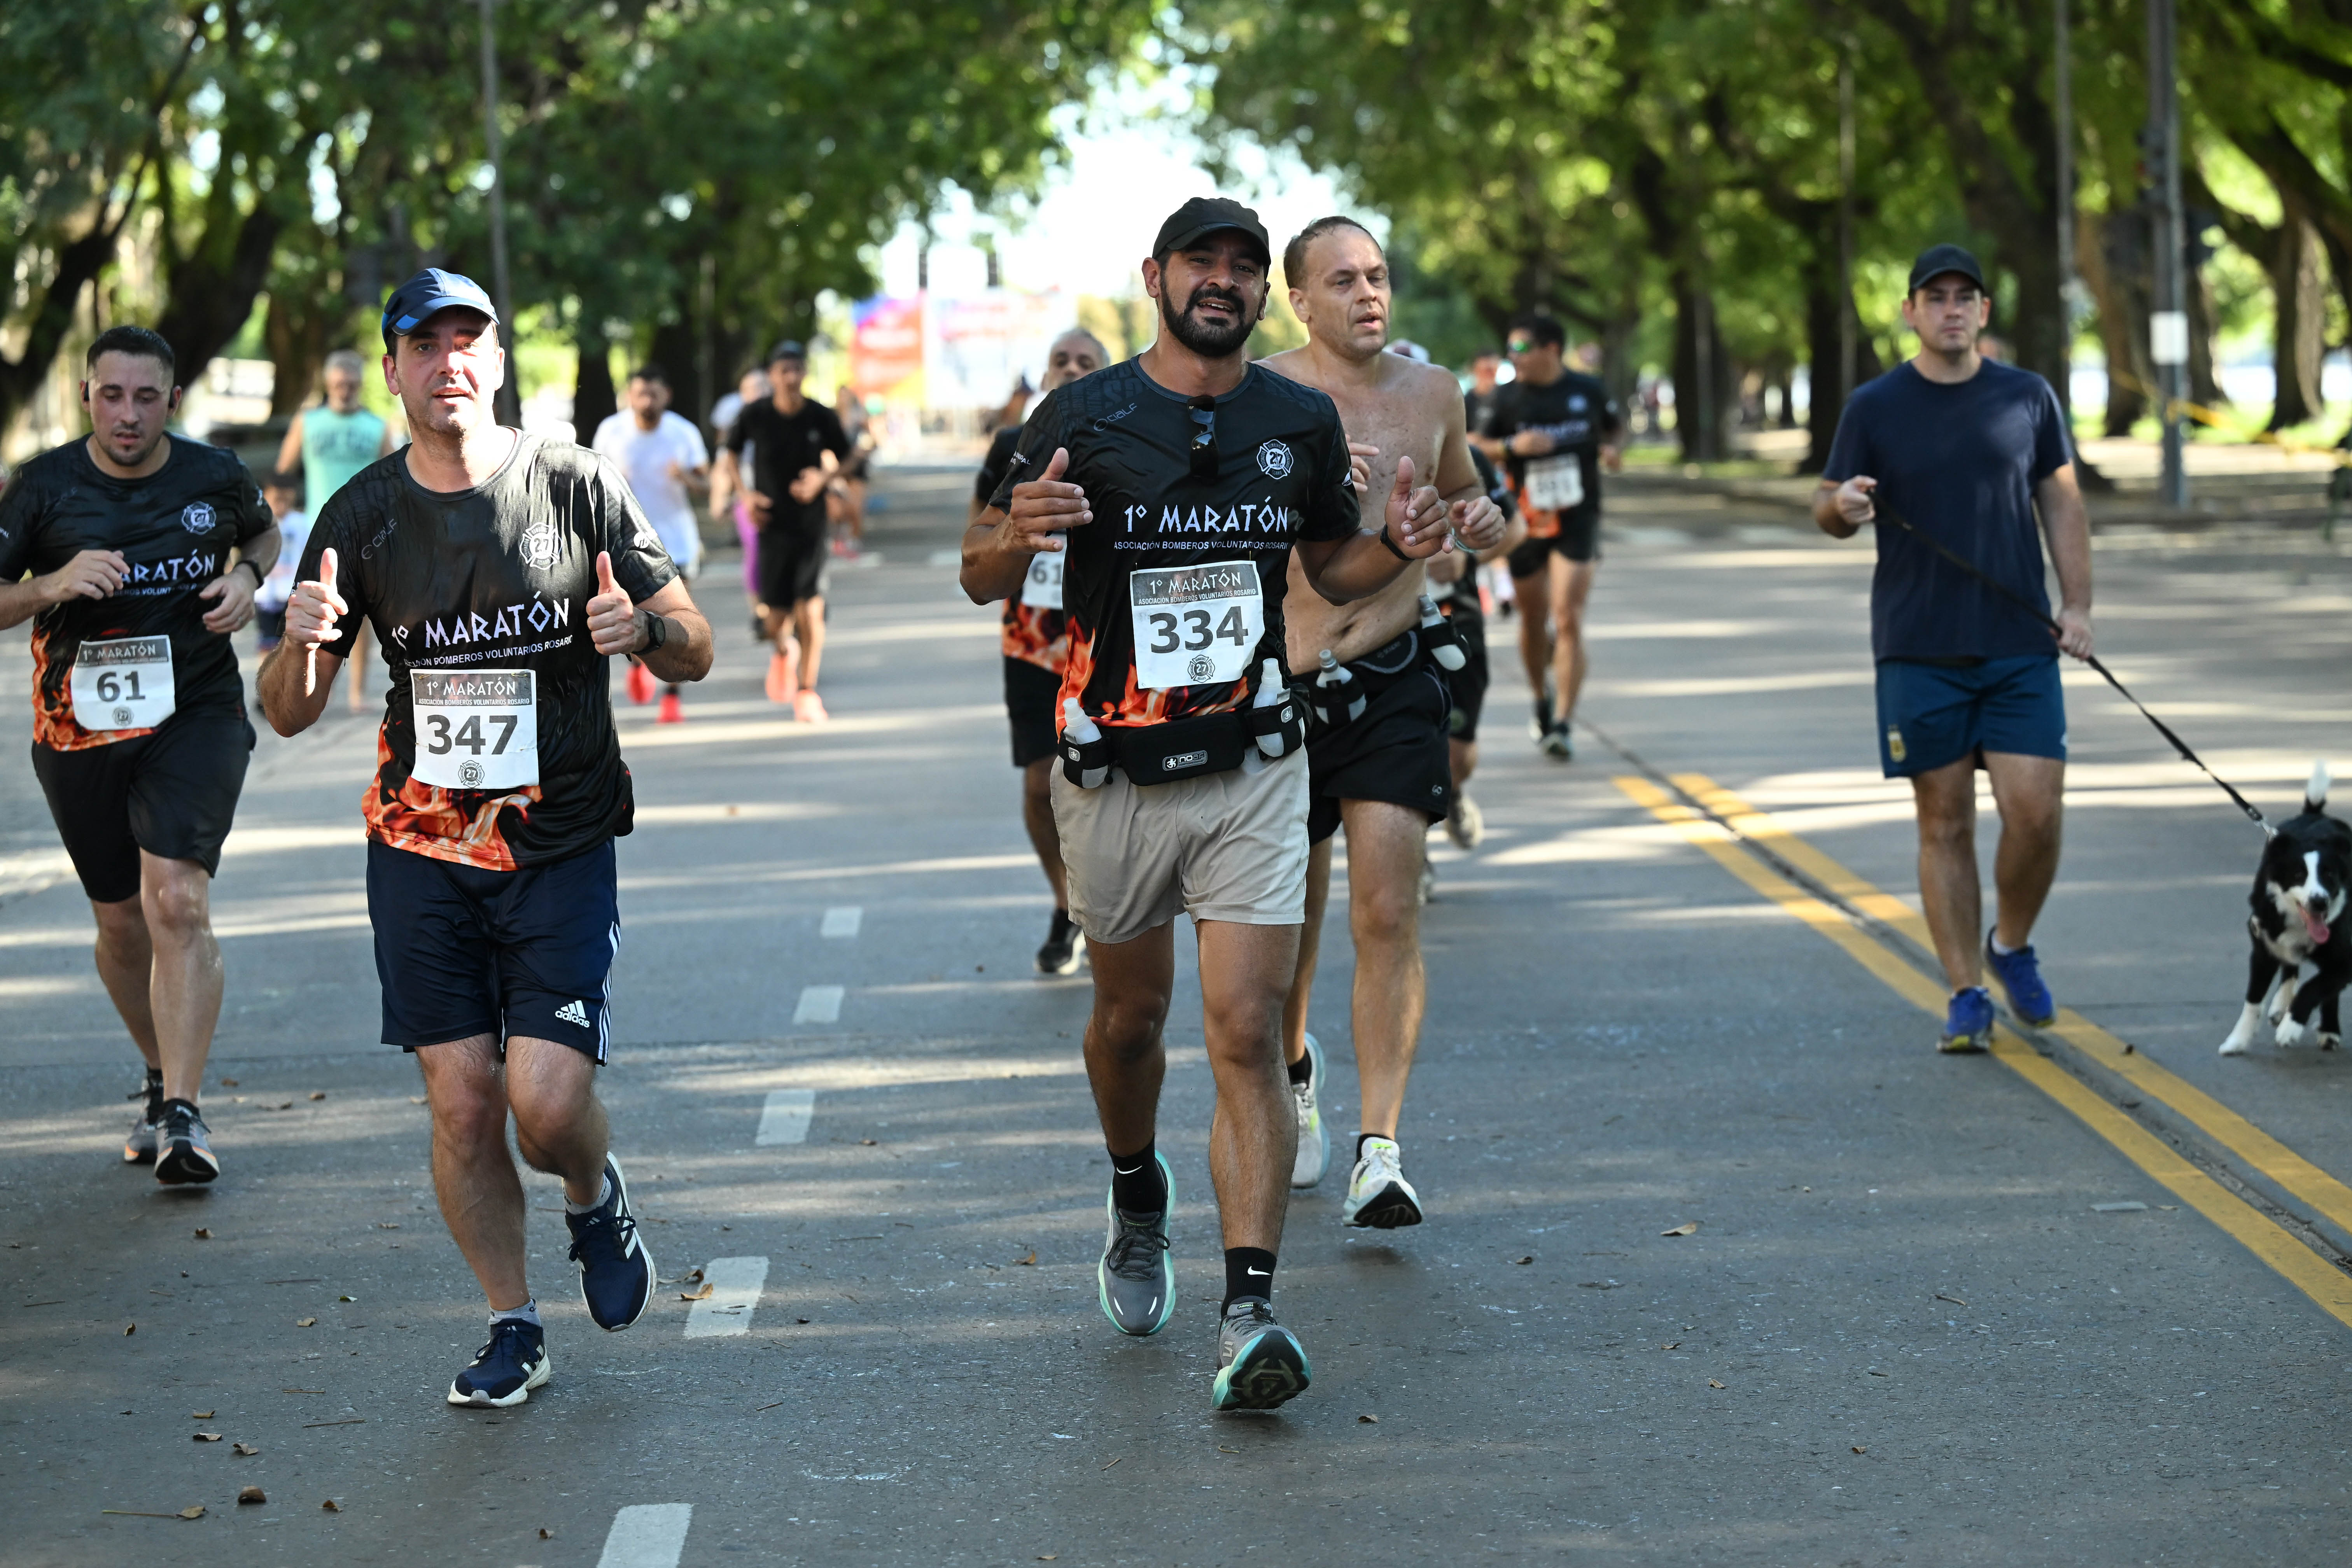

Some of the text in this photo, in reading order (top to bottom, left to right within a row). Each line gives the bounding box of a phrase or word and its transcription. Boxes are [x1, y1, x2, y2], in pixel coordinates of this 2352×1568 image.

[1269, 451, 1283, 464] 27
[1158, 495, 1288, 533] MARATÓN
[534, 538, 549, 553] 27
[1114, 541, 1160, 551] ASOCIACIÓN
[1162, 541, 1209, 550] BOMBEROS
[1211, 540, 1265, 550] VOLUNTARIOS
[119, 548, 215, 584] ARATÓN
[1168, 569, 1241, 593] MARATÓN
[1138, 588, 1256, 605] ASOCIACIÓN BOMBEROS VOLUNTARIOS ROSARIO
[425, 590, 569, 648] MARATÓN
[1150, 606, 1249, 654] 334
[97, 641, 156, 660] MARATÓN
[434, 651, 483, 665] BOMBEROS
[485, 642, 543, 659] VOLUNTARIOS
[1196, 663, 1206, 674] 27
[97, 670, 146, 702] 61
[443, 676, 516, 696] MARATÓN
[418, 697, 444, 705] ASOCIACIÓN
[427, 714, 518, 755] 347
[466, 768, 477, 779] 27
[555, 1010, 590, 1028] adidas
